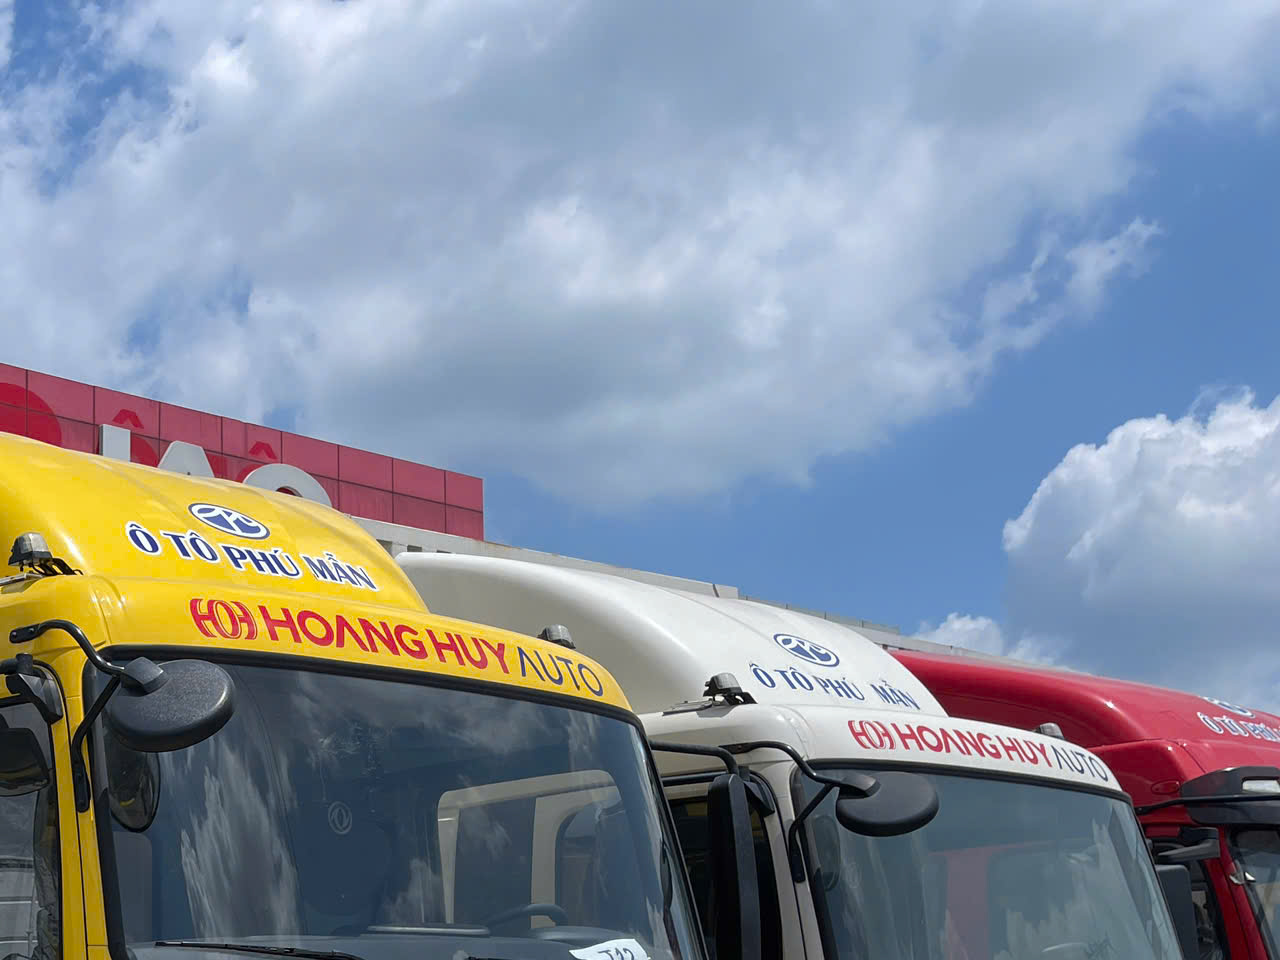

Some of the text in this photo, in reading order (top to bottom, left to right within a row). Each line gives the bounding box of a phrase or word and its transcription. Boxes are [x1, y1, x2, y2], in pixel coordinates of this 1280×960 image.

[127, 522, 378, 590] Ô TÔ PHÚ MẪN
[258, 605, 429, 660] HOANG
[428, 629, 511, 675] HUY
[516, 646, 604, 698] AUTO
[749, 662, 776, 688] Ô
[774, 666, 814, 691] TÔ
[889, 722, 1002, 759] HOANG
[997, 735, 1053, 768] HUY
[1050, 744, 1109, 783] AUTO
